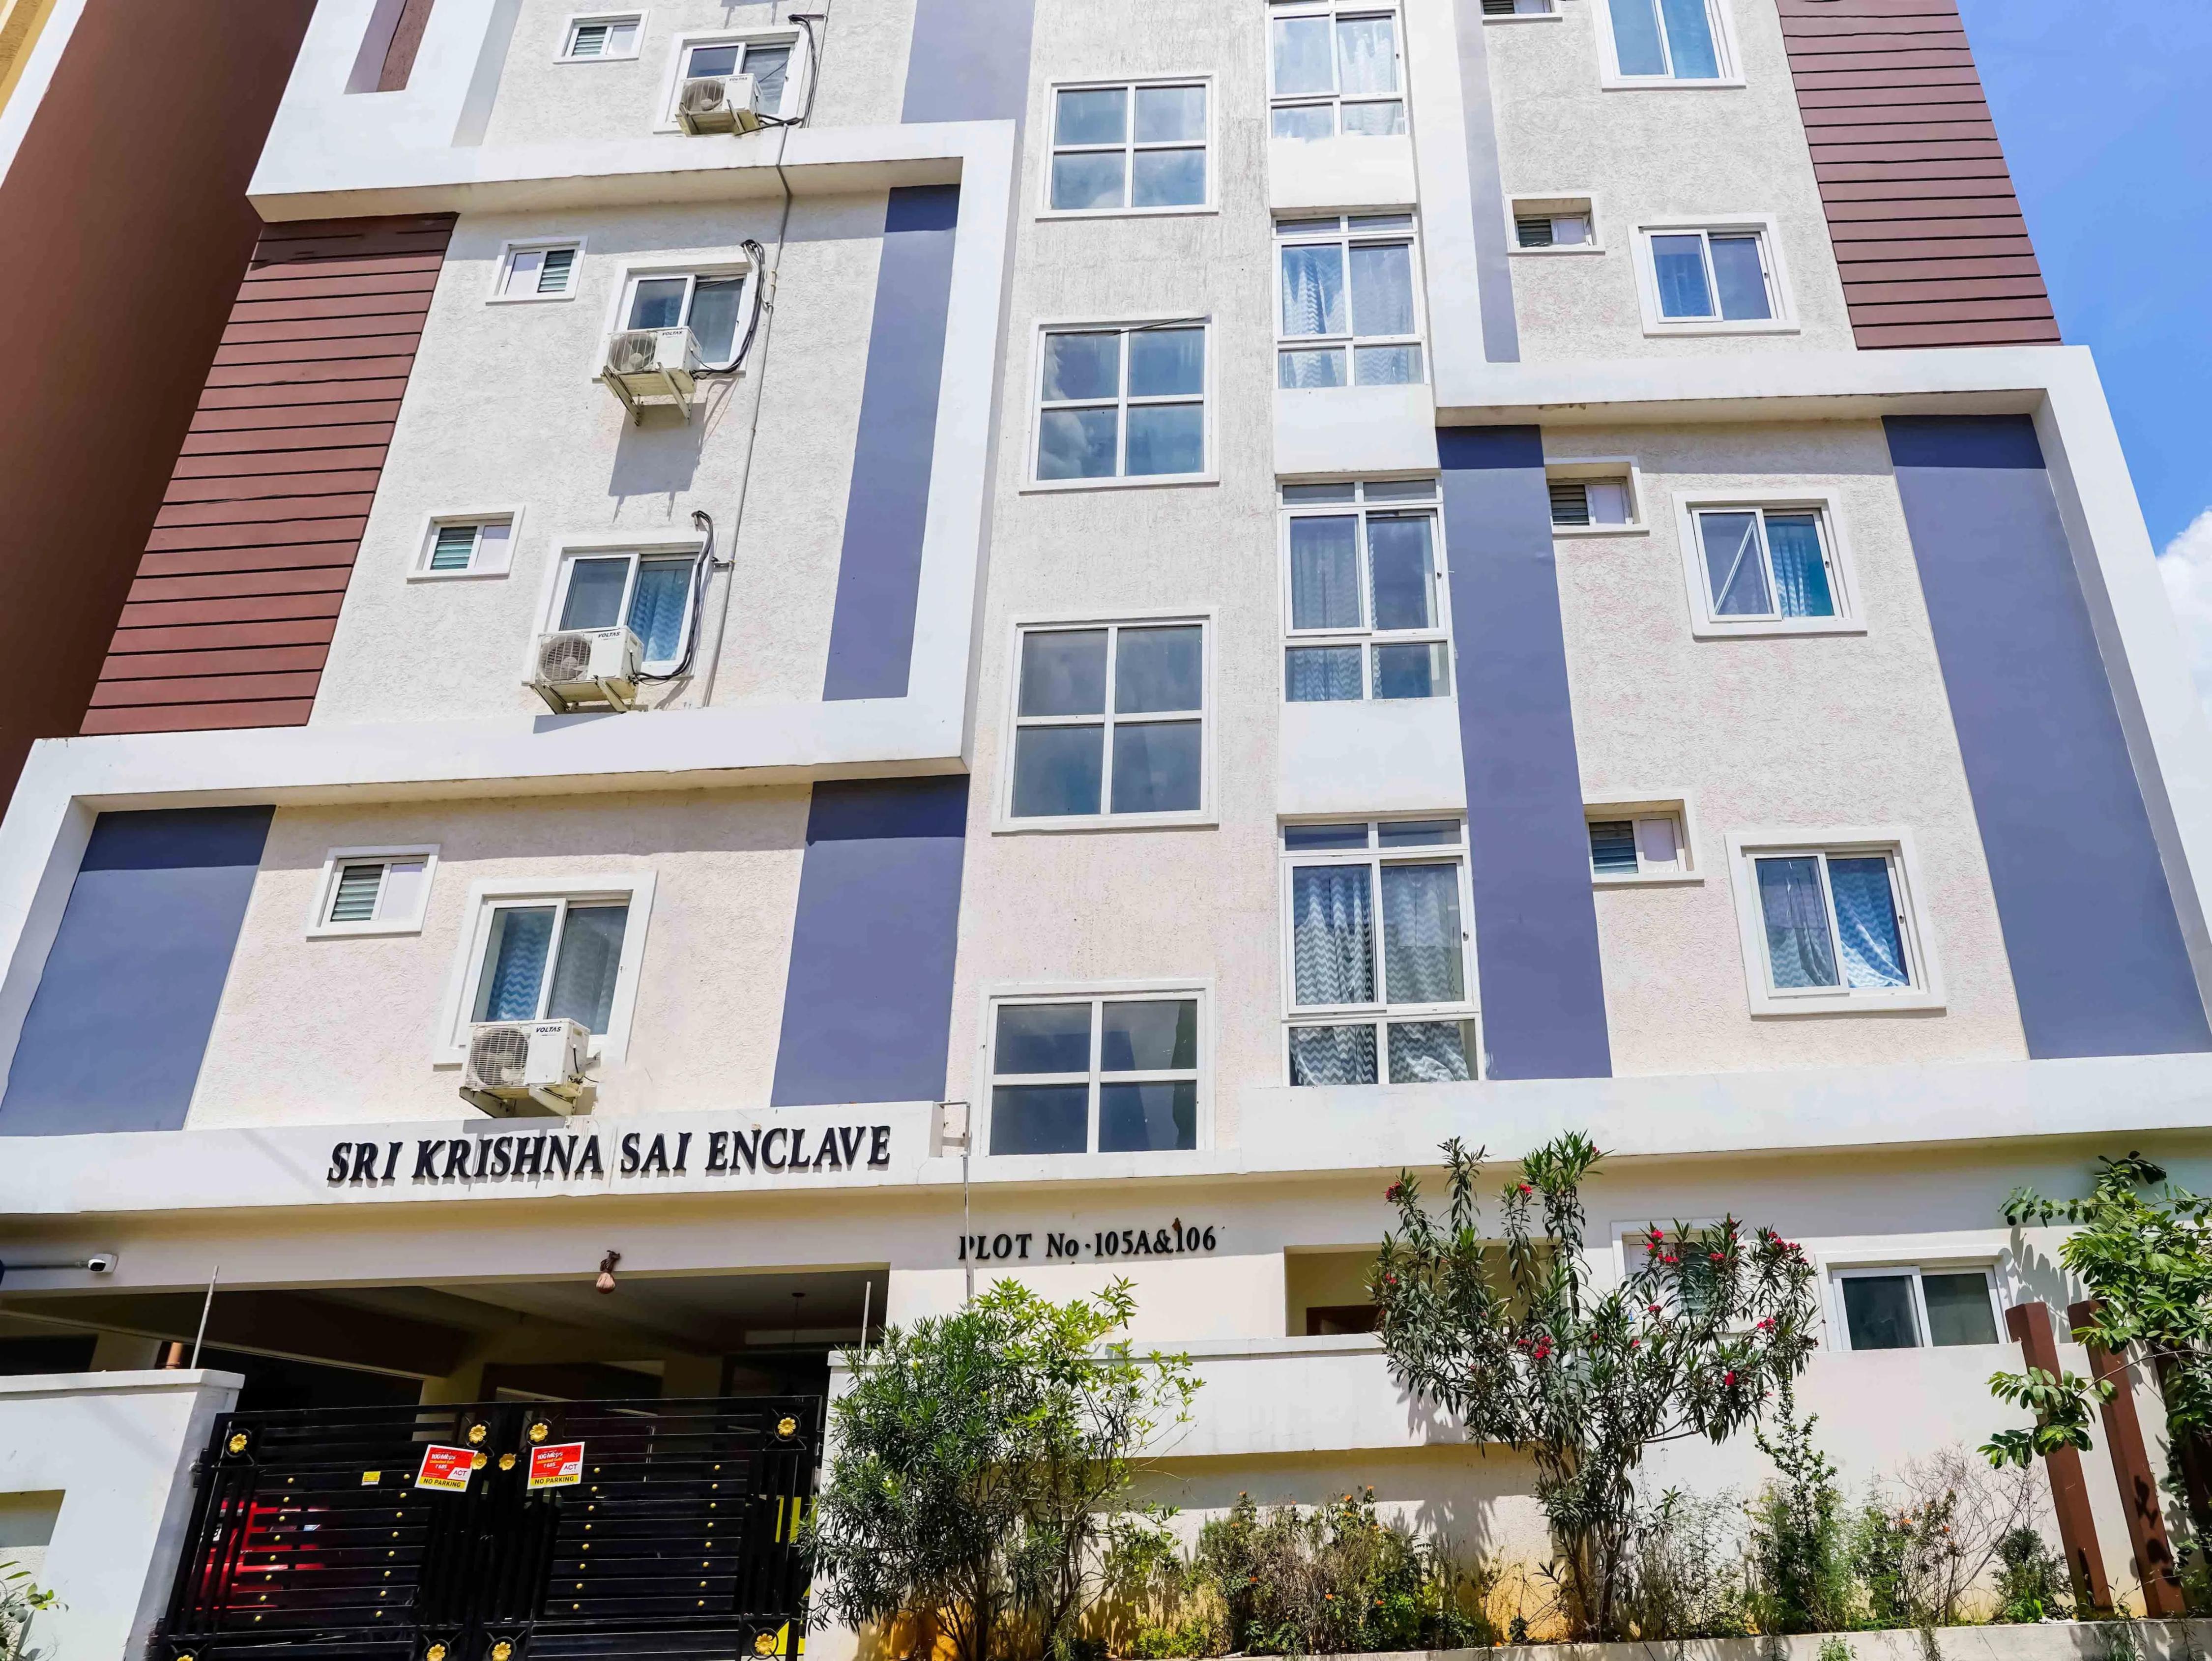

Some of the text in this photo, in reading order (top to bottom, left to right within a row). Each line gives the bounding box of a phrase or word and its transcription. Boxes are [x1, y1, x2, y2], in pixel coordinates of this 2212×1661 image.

[327, 1126, 890, 1180] SRI KRISHNA SAI ENCLAVE
[958, 1233, 1032, 1259] PLOT
[434, 1479, 461, 1487] PARKING
